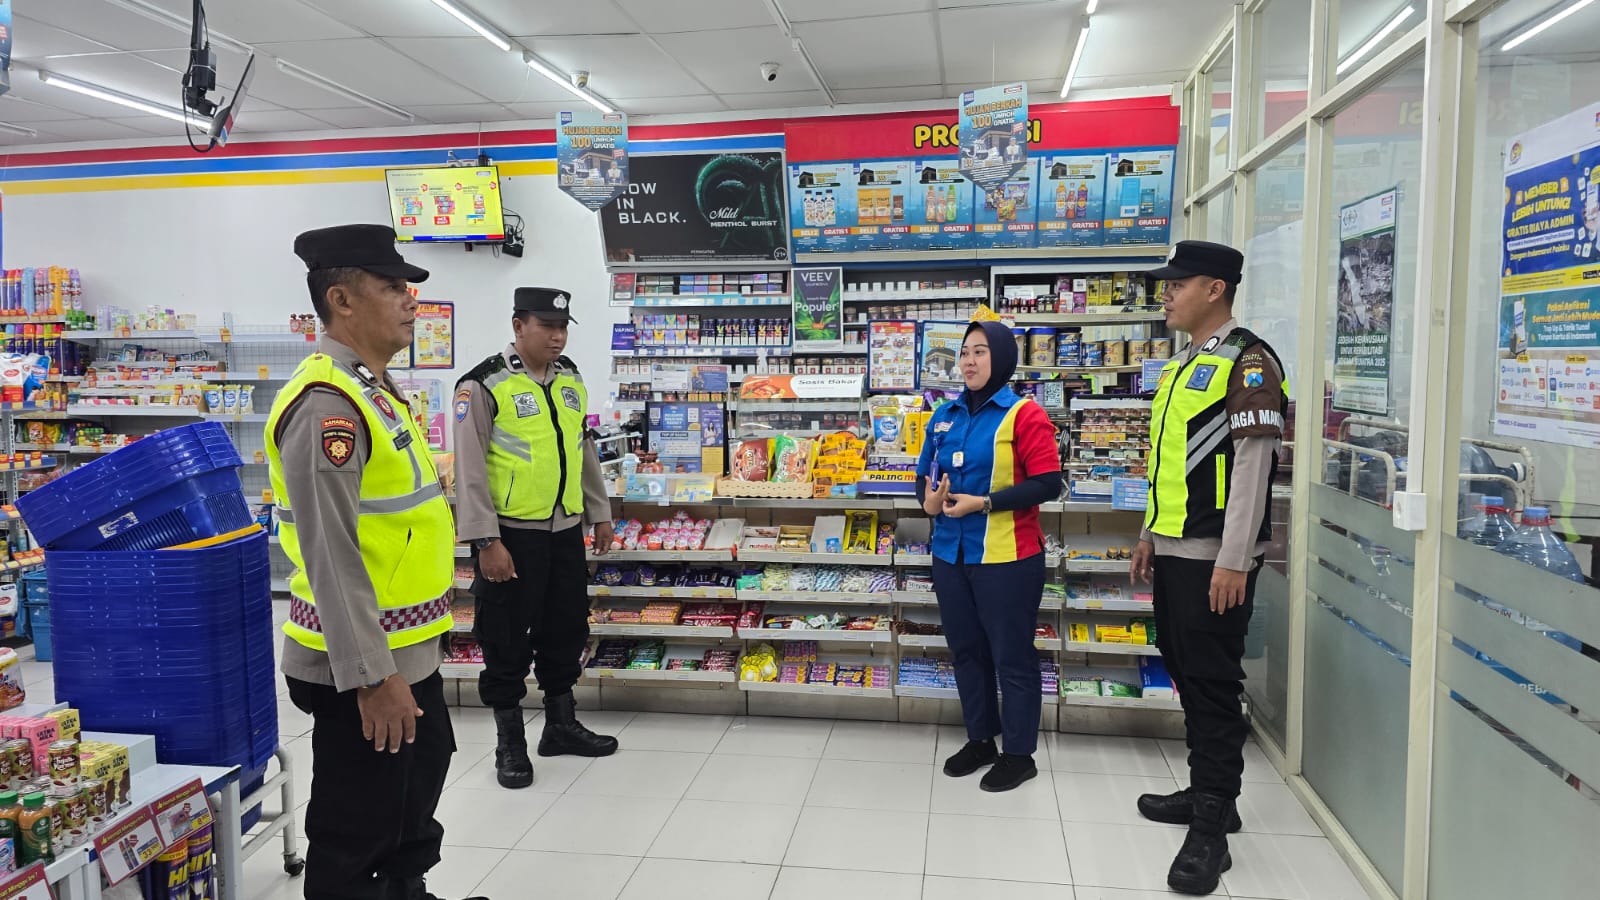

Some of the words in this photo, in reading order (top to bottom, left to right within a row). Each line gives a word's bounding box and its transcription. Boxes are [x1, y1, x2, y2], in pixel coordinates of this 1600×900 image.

[964, 102, 990, 117] HUJAN
[991, 98, 1022, 112] BERKAH
[972, 114, 992, 129] 100
[993, 117, 1015, 126] GRATIS
[562, 126, 589, 135] HUJAN
[590, 126, 622, 135] BERKAH
[570, 136, 591, 149] 100
[622, 183, 657, 196] OW
[1524, 181, 1559, 202] MEMBER
[616, 198, 635, 210] IN
[618, 211, 687, 225] BLACK.
[709, 207, 739, 220] Mild
[1512, 203, 1535, 223] LEBIH
[710, 220, 748, 228] MENTHOL
[751, 219, 778, 228] BURST
[982, 224, 996, 232] BELI
[1072, 222, 1094, 230] GRATIS
[1138, 219, 1161, 227] GRATIS
[1507, 225, 1529, 238] GRATIS
[1529, 220, 1550, 234] BIAYA
[1550, 214, 1575, 229] ADMIN
[800, 229, 813, 237] BELI
[823, 228, 845, 236] GRATIS
[882, 226, 904, 234] GRATIS
[800, 271, 833, 283] VEEV
[795, 301, 836, 314] Populer
[1230, 410, 1256, 430] JAGA
[61, 717, 77, 727] ULTRA
[62, 722, 75, 730] MILK
[36, 728, 56, 738] ULTRA
[39, 733, 54, 741] MILK
[94, 764, 111, 774] ULTRA
[96, 770, 109, 779] MILK
[142, 848, 152, 859] 33
[188, 848, 212, 872] HIT
[168, 864, 188, 888] HI
